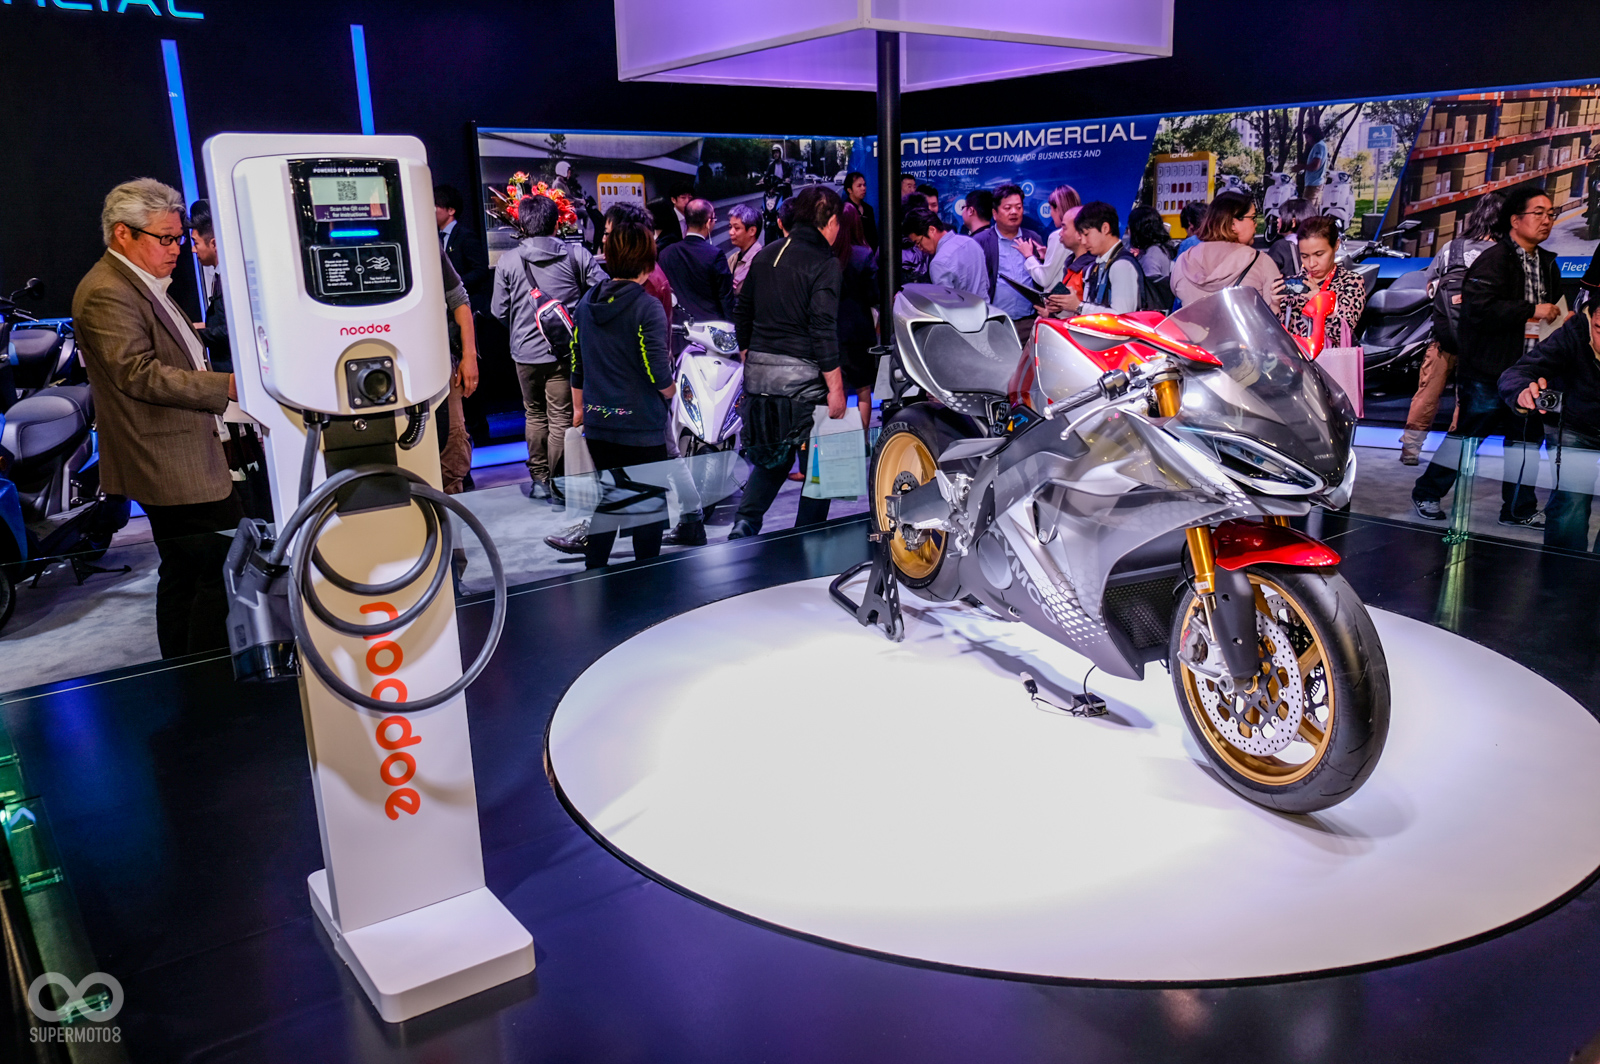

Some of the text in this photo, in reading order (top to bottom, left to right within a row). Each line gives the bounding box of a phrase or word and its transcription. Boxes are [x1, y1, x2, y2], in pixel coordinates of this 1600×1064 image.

[872, 121, 1147, 157] inex COMMERCIAL
[952, 156, 983, 165] TURNKEY
[985, 154, 1021, 164] SOLUTION
[1021, 153, 1036, 161] FOR
[1038, 150, 1082, 160] BUSINESSES
[1083, 149, 1101, 158] AND
[928, 169, 936, 177] TO
[938, 169, 948, 177] GO
[949, 168, 980, 177] ELECTRIC
[1561, 261, 1587, 272] Fleet
[339, 323, 391, 336] noodoe
[359, 601, 422, 821] noodoe
